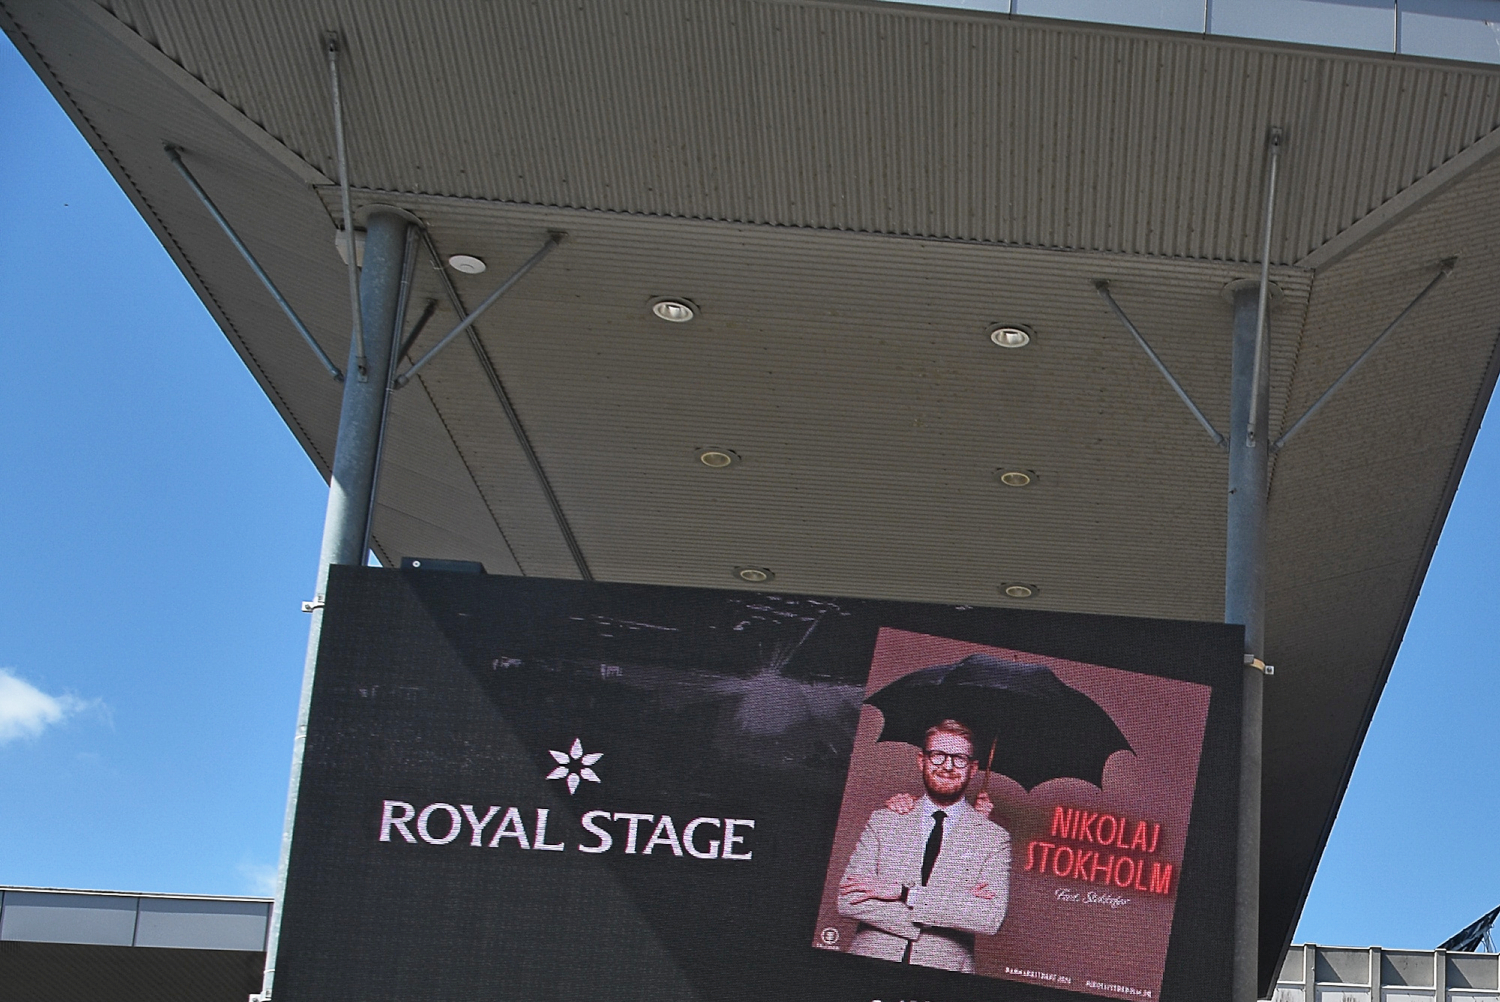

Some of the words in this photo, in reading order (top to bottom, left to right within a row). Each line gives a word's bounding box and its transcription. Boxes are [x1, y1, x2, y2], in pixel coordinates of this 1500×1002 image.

[378, 800, 565, 852] ROYAL
[578, 810, 756, 861] STAGE
[1051, 805, 1161, 853] NIKOLAJ
[1024, 840, 1173, 895] STOKHOLM
